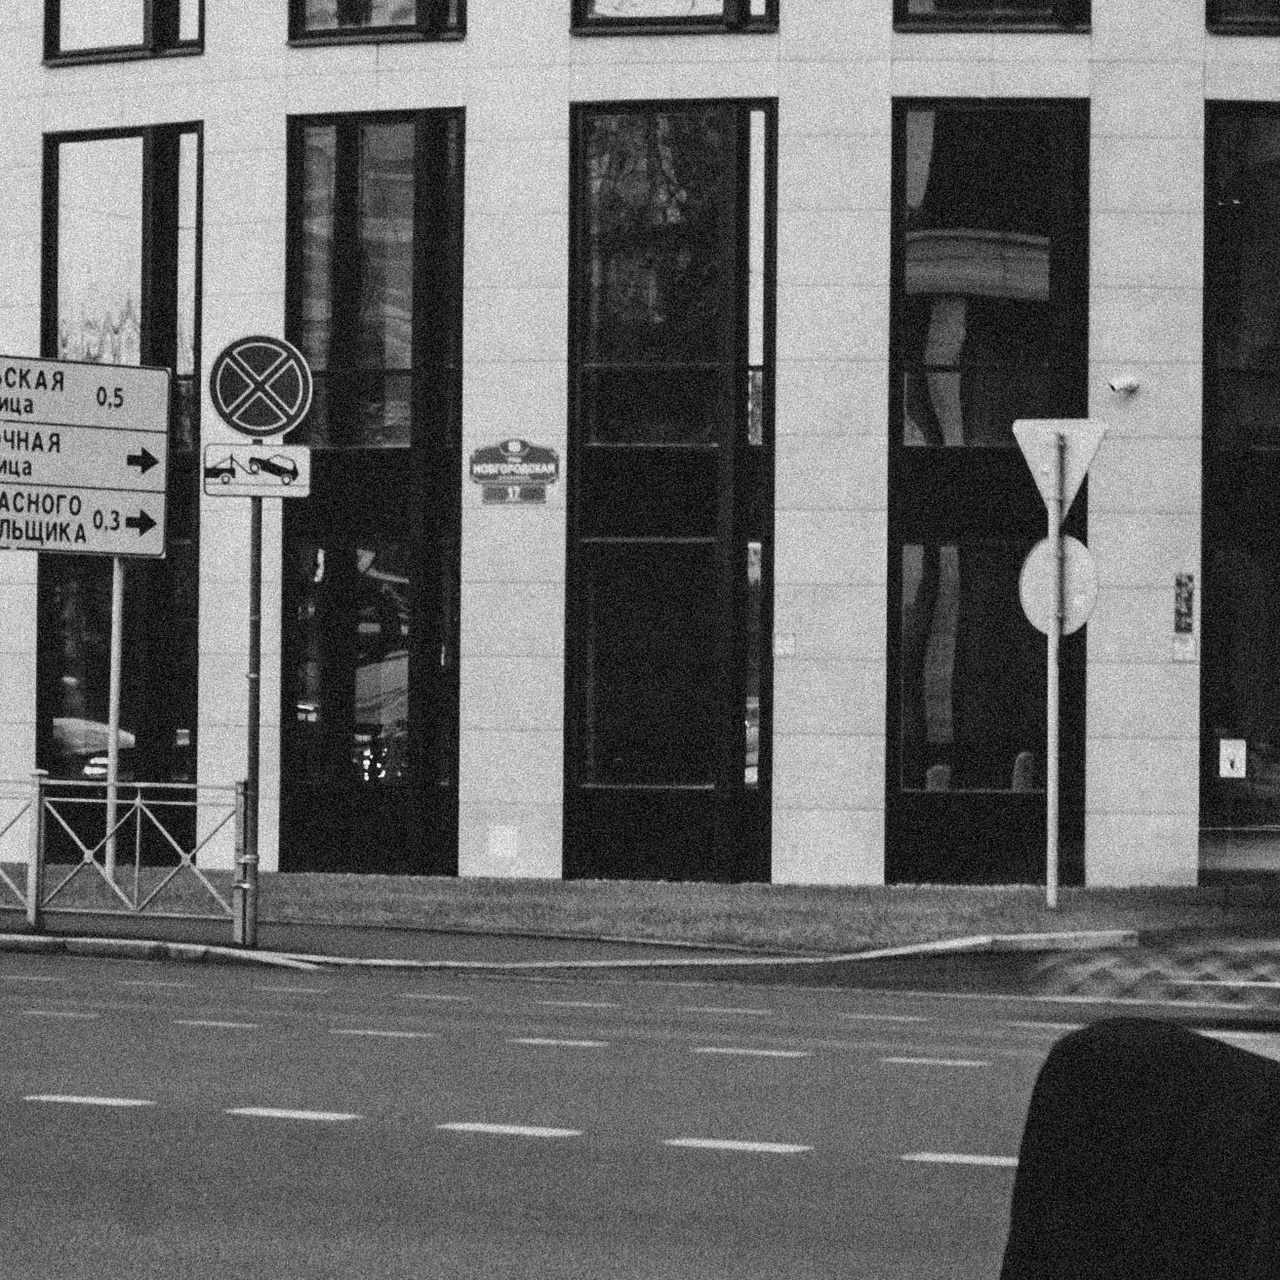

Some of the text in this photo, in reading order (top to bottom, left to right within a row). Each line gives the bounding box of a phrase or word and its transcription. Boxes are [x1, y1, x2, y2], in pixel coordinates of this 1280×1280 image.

[0, 366, 65, 392] СКАЯ
[0, 429, 61, 454] ЧНАЯ
[472, 463, 556, 474] НОВГОРОДСКАЯ
[0, 491, 82, 516] АСНОГО
[507, 486, 521, 499] 17
